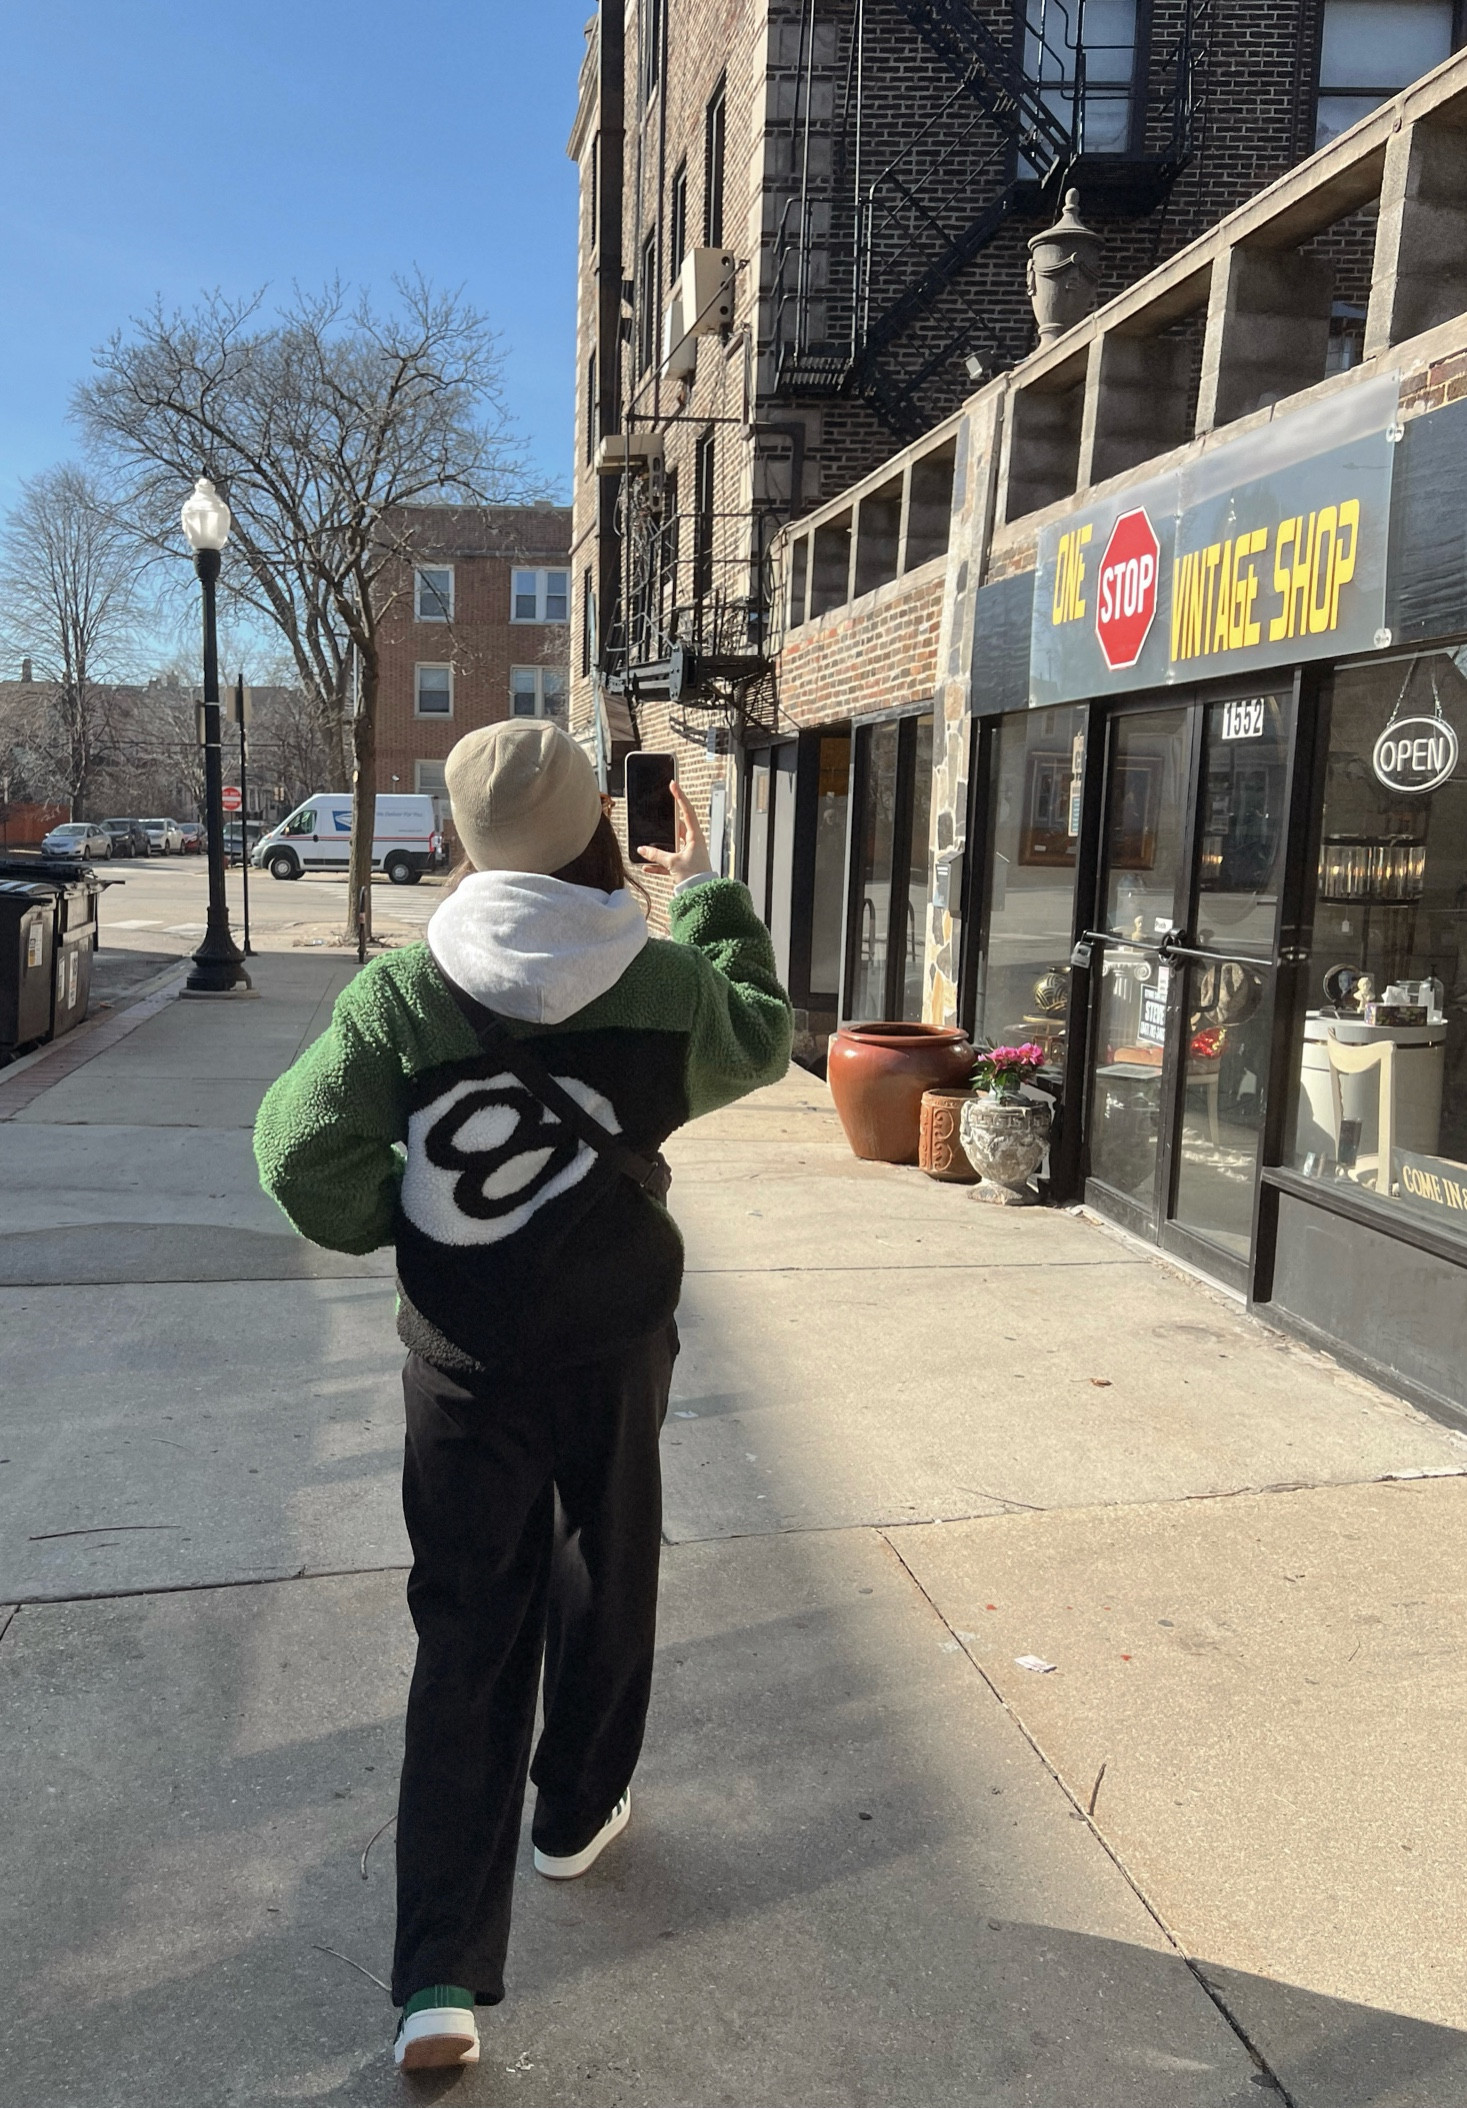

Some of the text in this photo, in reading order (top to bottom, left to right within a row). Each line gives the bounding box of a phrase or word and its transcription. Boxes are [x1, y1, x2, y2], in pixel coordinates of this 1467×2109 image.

[1052, 498, 1360, 662] ONE STOP VINTAGE SHOP
[1222, 698, 1262, 737] 1552
[1380, 737, 1444, 772] OPEN
[1403, 1166, 1444, 1203] COME
[1441, 1177, 1463, 1210] IN
